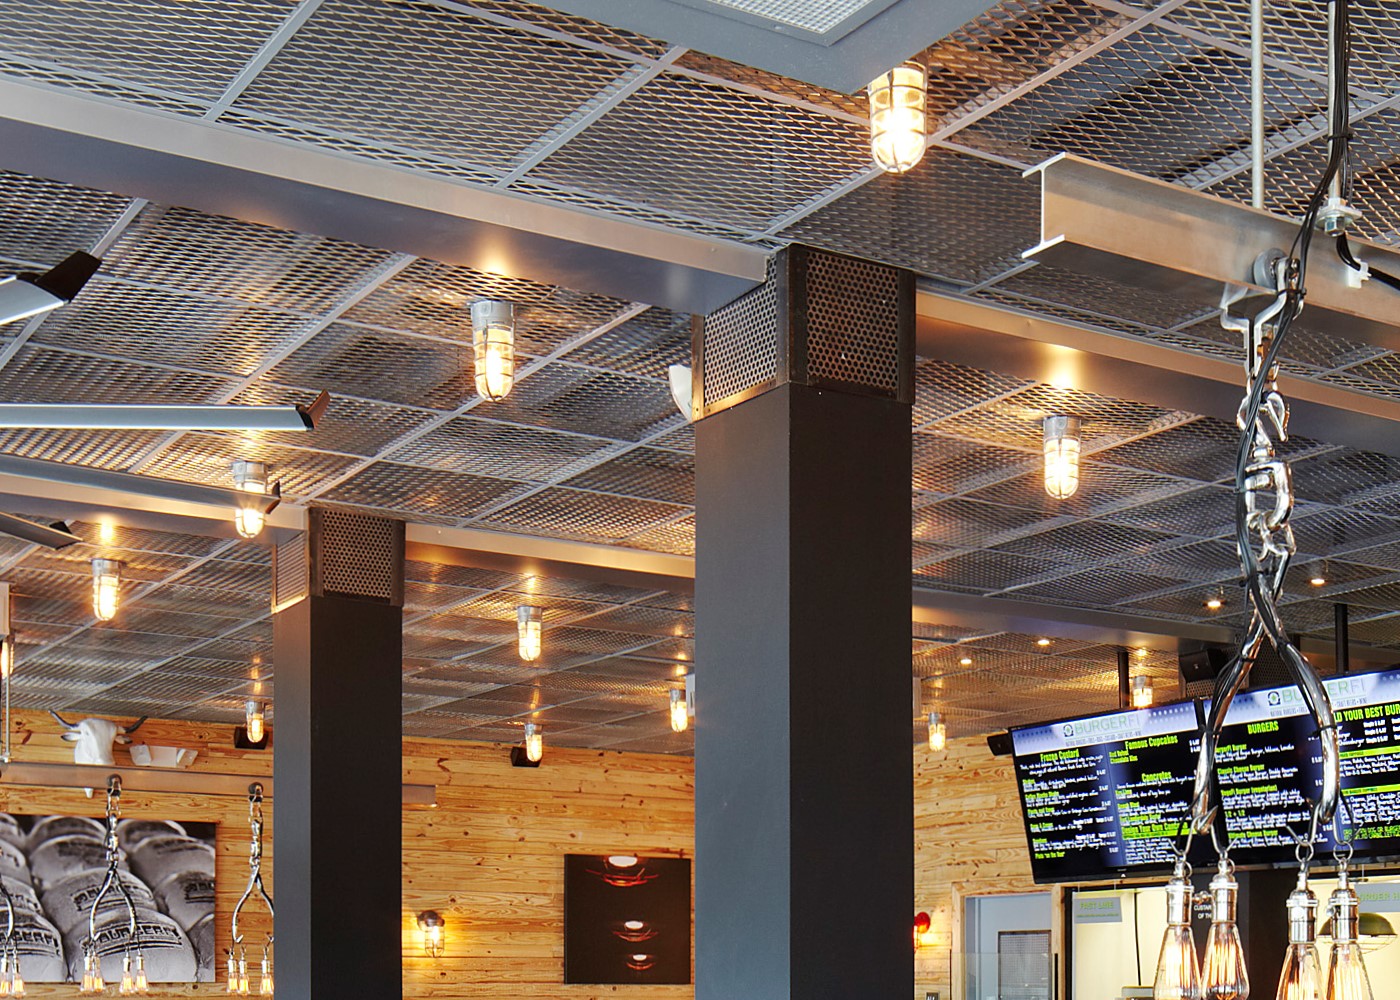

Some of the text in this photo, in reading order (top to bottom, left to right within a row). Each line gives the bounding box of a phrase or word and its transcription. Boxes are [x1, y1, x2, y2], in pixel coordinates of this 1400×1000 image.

[1343, 710, 1364, 721] YOUR
[1365, 706, 1383, 718] BEST
[1247, 721, 1279, 735] BURGERS
[1125, 740, 1148, 750] Famous
[1149, 735, 1178, 747] Cupcakes
[1142, 771, 1171, 782] Concretes
